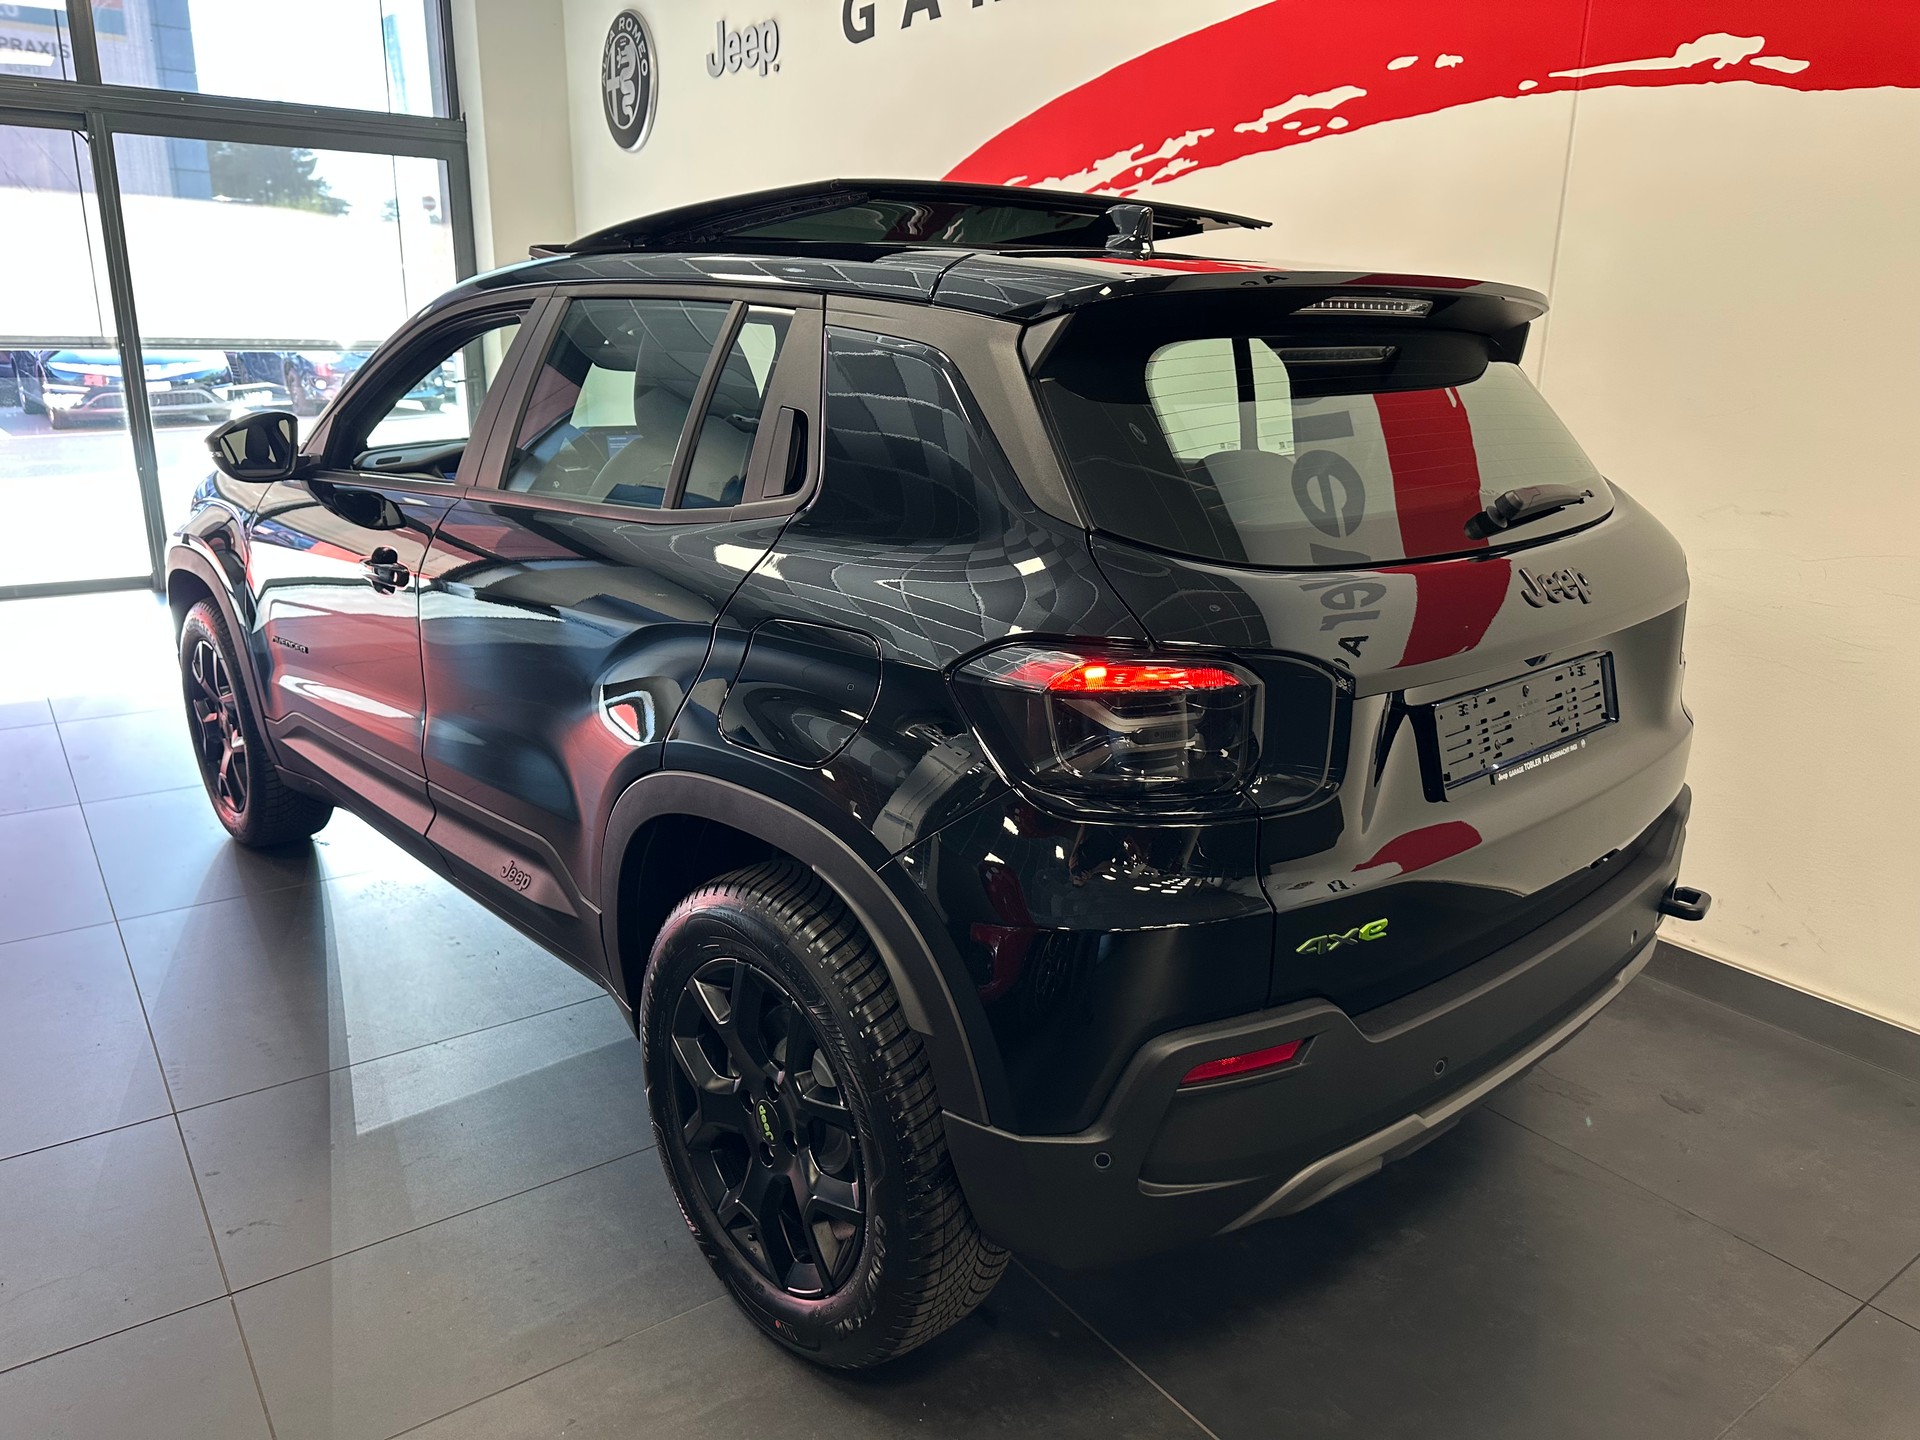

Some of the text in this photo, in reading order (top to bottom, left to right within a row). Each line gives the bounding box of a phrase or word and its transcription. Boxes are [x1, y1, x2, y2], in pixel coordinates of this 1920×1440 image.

[618, 16, 648, 77] ROMEO
[1518, 566, 1592, 608] Jeep
[1509, 766, 1524, 777] GARAGE
[1524, 758, 1541, 770] TOBLER
[1542, 754, 1549, 764] AG
[501, 860, 531, 891] Jeep
[759, 1104, 774, 1141] Jeep
